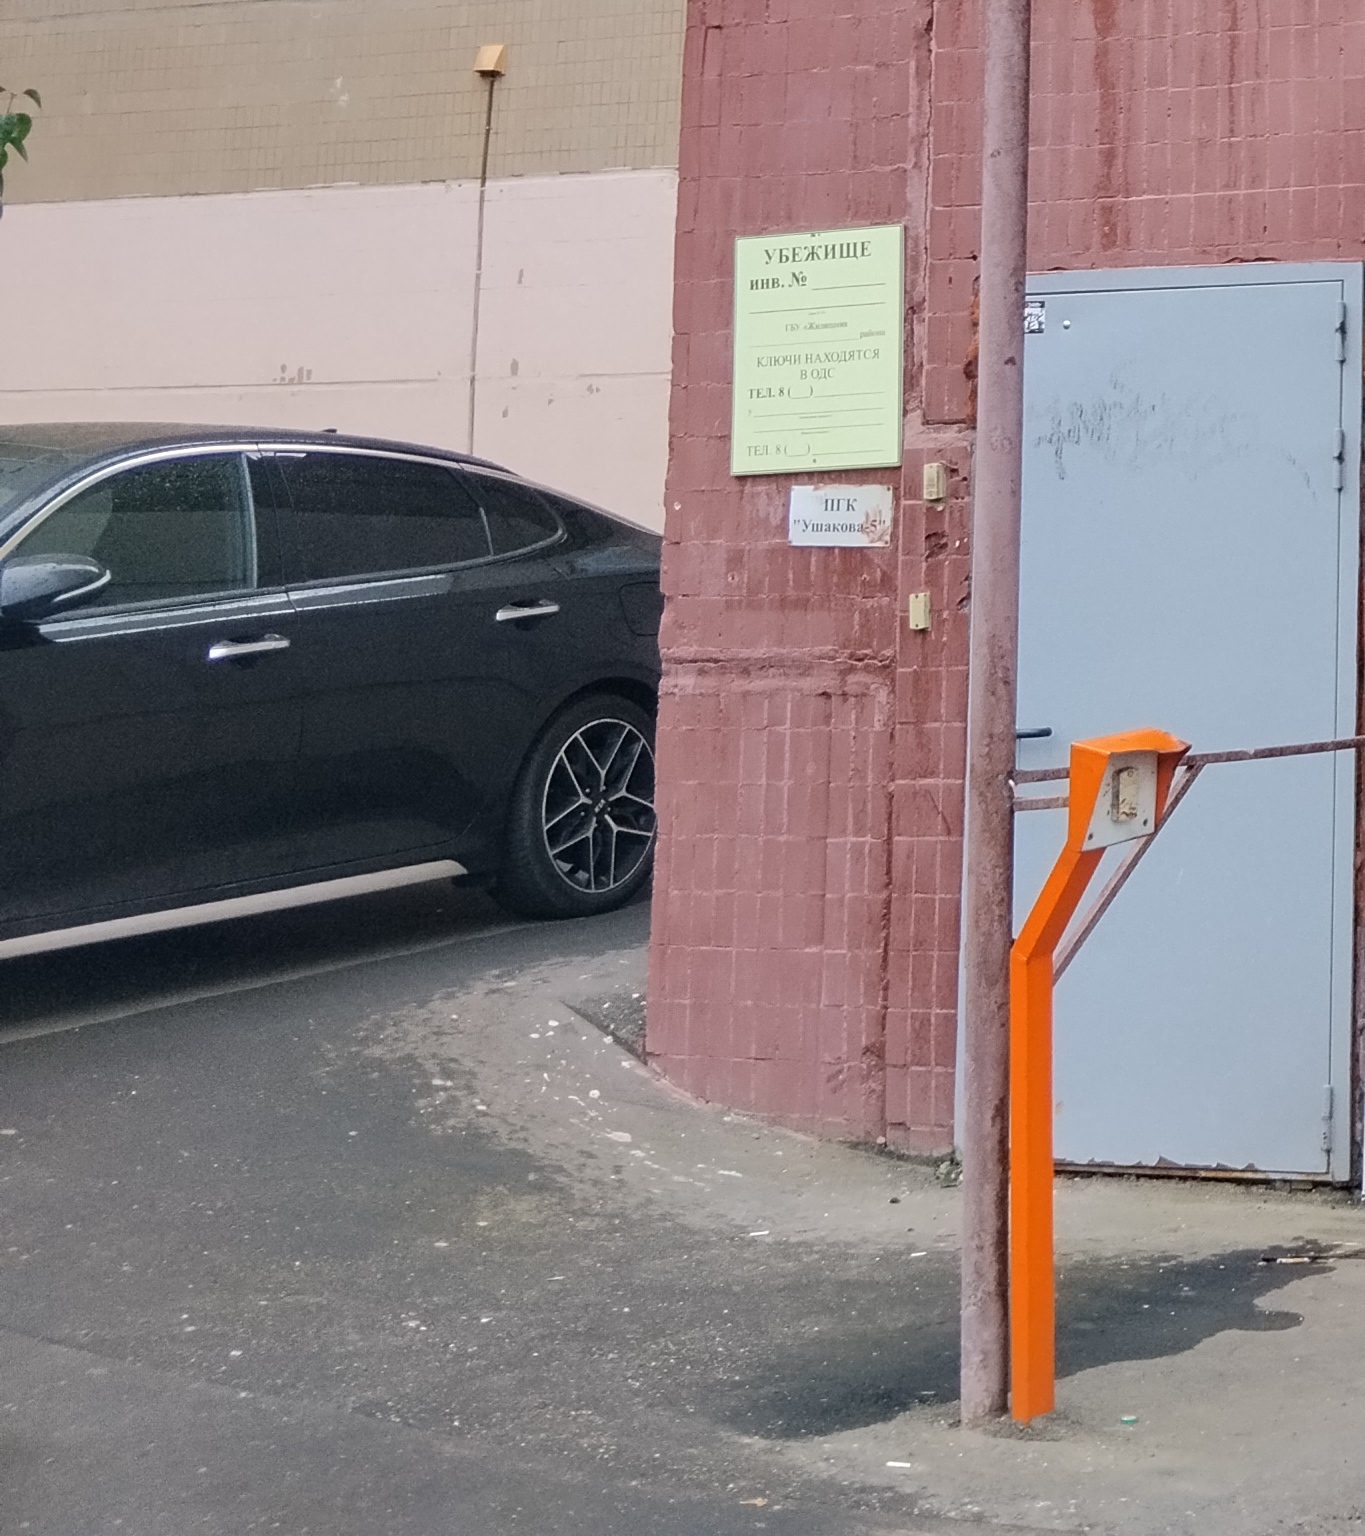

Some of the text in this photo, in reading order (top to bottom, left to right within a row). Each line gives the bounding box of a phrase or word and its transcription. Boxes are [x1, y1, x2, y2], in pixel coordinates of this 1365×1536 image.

[764, 241, 872, 265] УБЕЖИЩЕ
[756, 348, 880, 368] КЛЮЧИ НАХОДЯТСЯ
[800, 367, 836, 380] В ОДС
[748, 387, 775, 399] ТЕЛ.
[778, 386, 785, 398] 8
[775, 444, 782, 454] 8
[824, 498, 858, 512] ПГК
